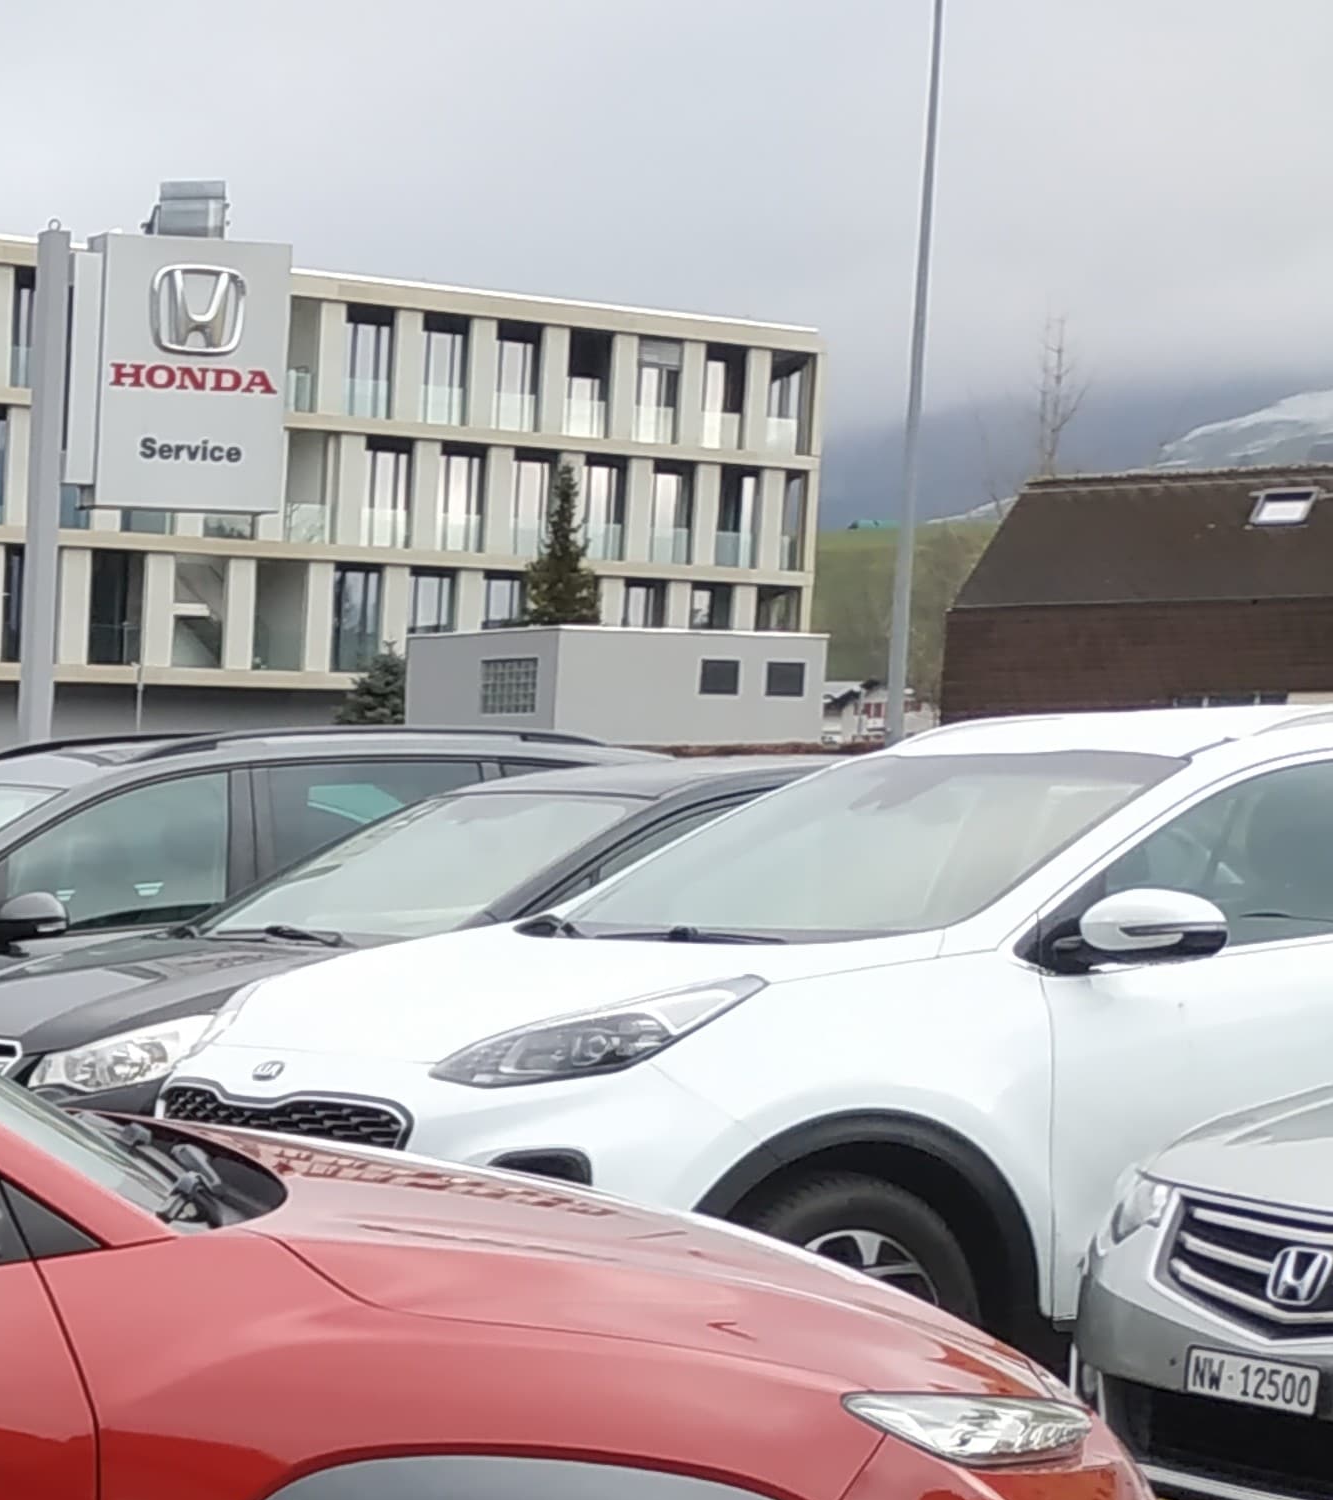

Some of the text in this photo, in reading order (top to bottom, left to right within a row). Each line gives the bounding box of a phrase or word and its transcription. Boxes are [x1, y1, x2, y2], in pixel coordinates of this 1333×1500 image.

[109, 362, 277, 395] HONDA
[139, 436, 243, 463] Service
[1192, 1355, 1312, 1407] NW 12500
